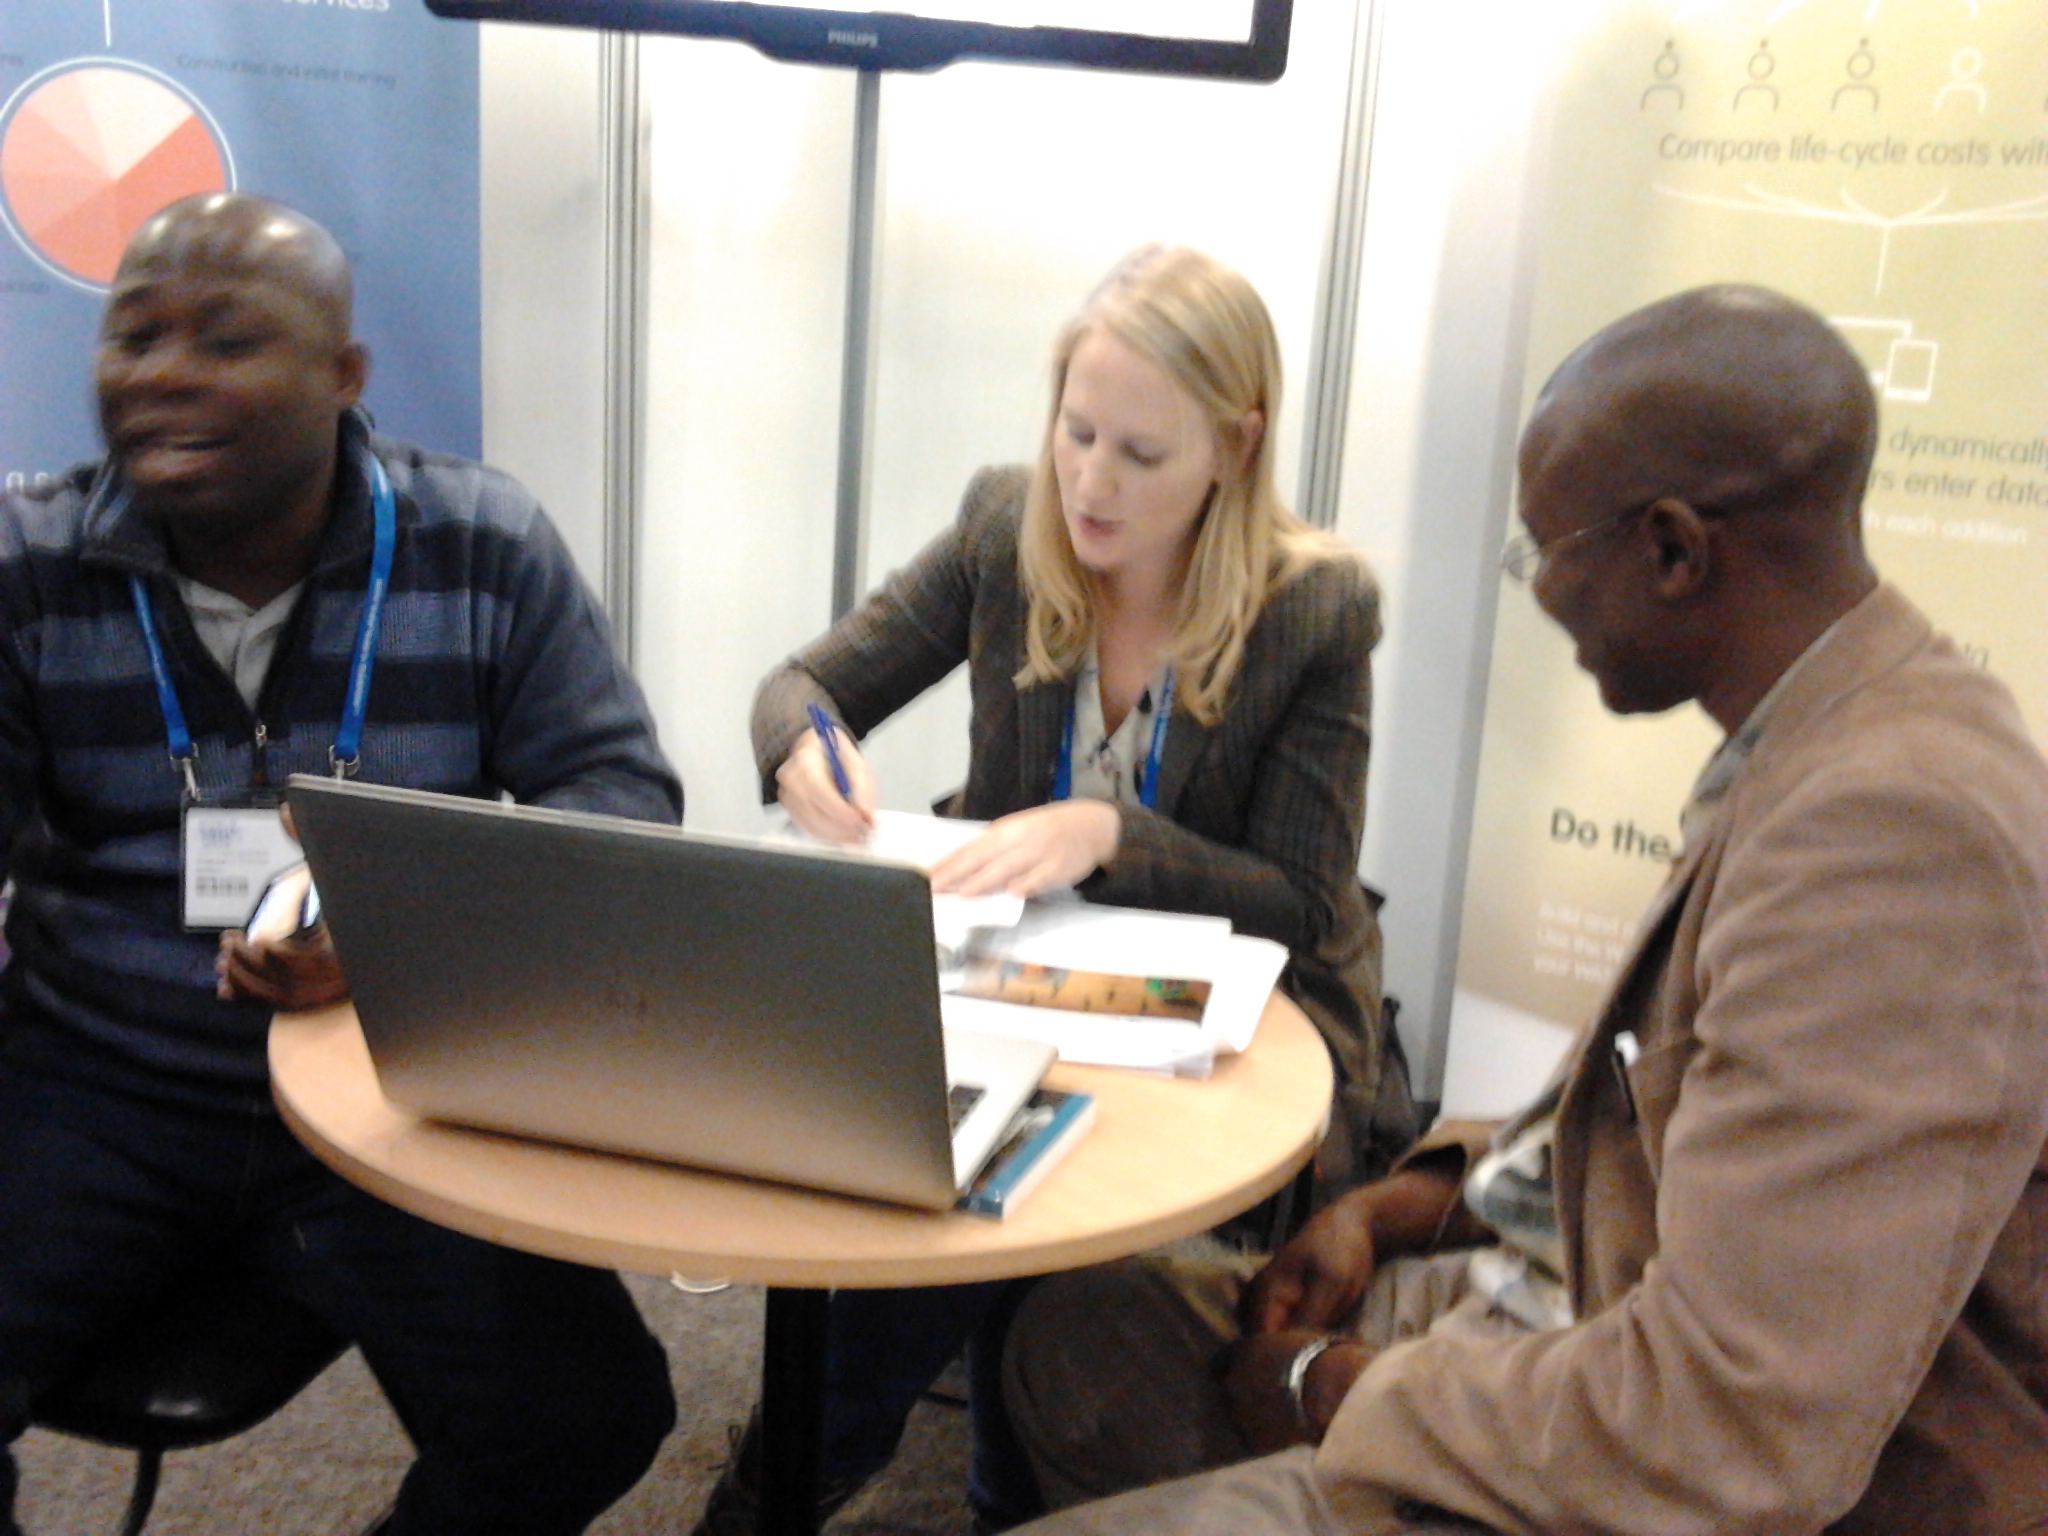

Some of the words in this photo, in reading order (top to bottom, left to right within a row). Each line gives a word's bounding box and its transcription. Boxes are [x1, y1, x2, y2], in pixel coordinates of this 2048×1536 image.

[1658, 131, 1781, 167] Compare
[1788, 133, 1908, 170] life-cycle
[1916, 138, 1991, 165] costs
[1889, 425, 2048, 472] dynamicall
[1903, 472, 1977, 500] enter
[1550, 807, 1599, 848] Do
[1612, 818, 1672, 862] the
